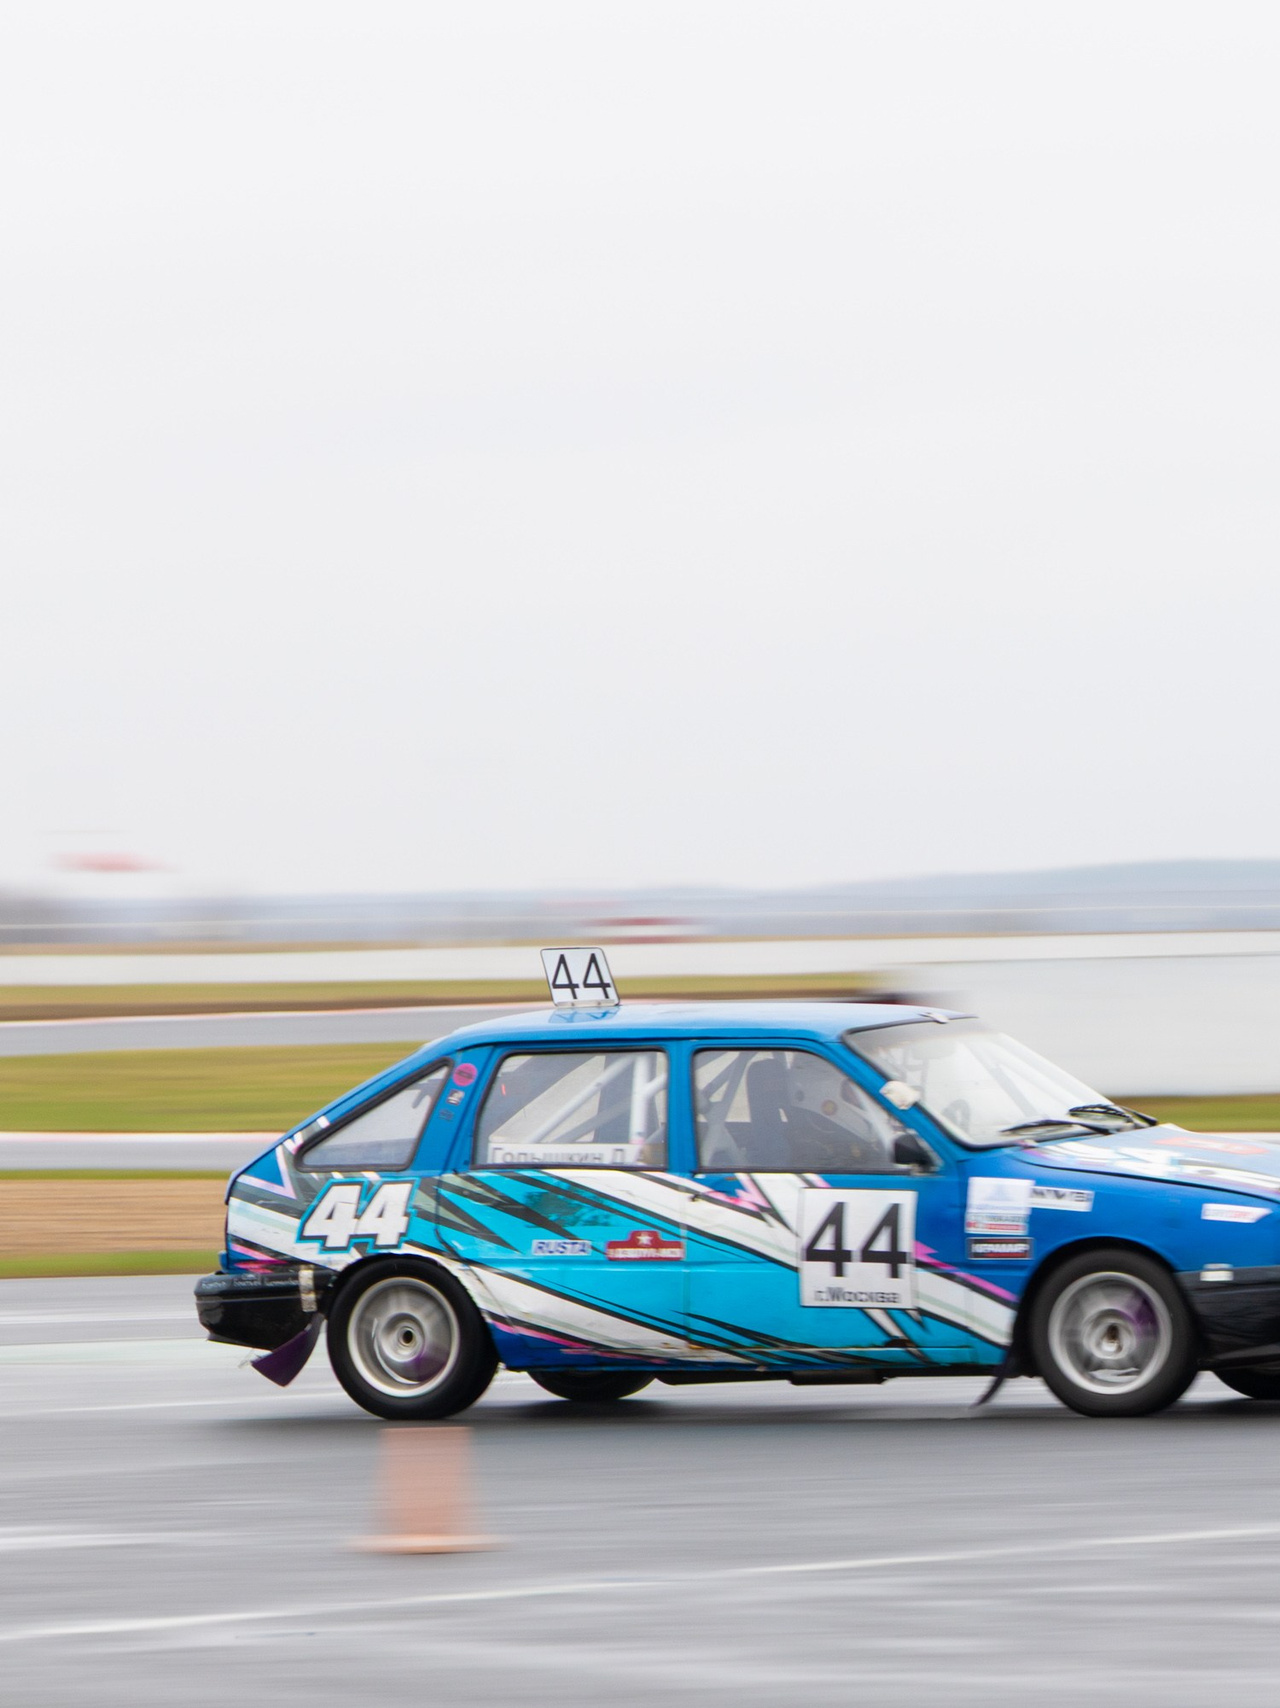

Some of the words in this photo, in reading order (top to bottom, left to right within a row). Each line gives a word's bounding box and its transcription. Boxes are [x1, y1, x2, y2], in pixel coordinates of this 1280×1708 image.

[551, 952, 611, 1000] 44
[299, 1180, 416, 1250] 44
[803, 1201, 909, 1279] 44
[534, 1241, 590, 1255] RUSTA
